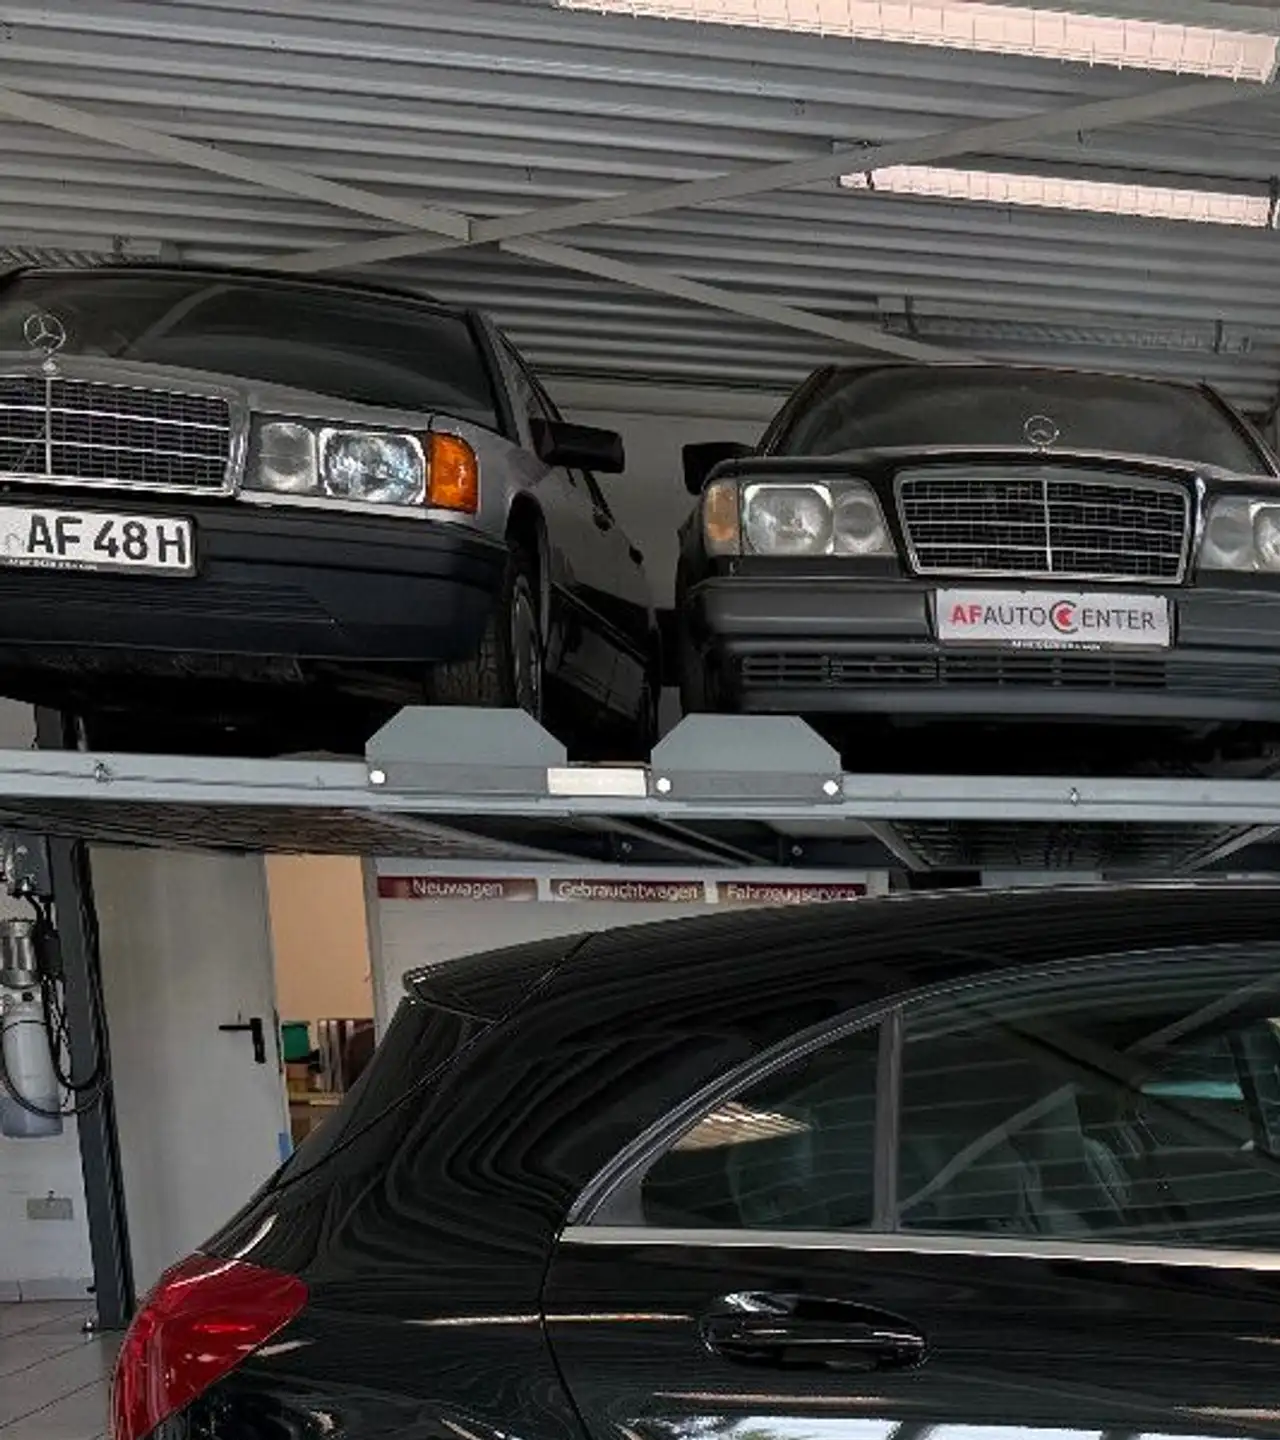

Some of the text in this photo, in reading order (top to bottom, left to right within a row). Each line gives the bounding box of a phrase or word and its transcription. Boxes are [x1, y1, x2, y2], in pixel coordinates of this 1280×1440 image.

[27, 514, 83, 556] AF
[412, 878, 503, 898] Neuwagen
[558, 880, 699, 901] Gebrauchtwagen
[727, 883, 857, 903] Fahrzeugservice
